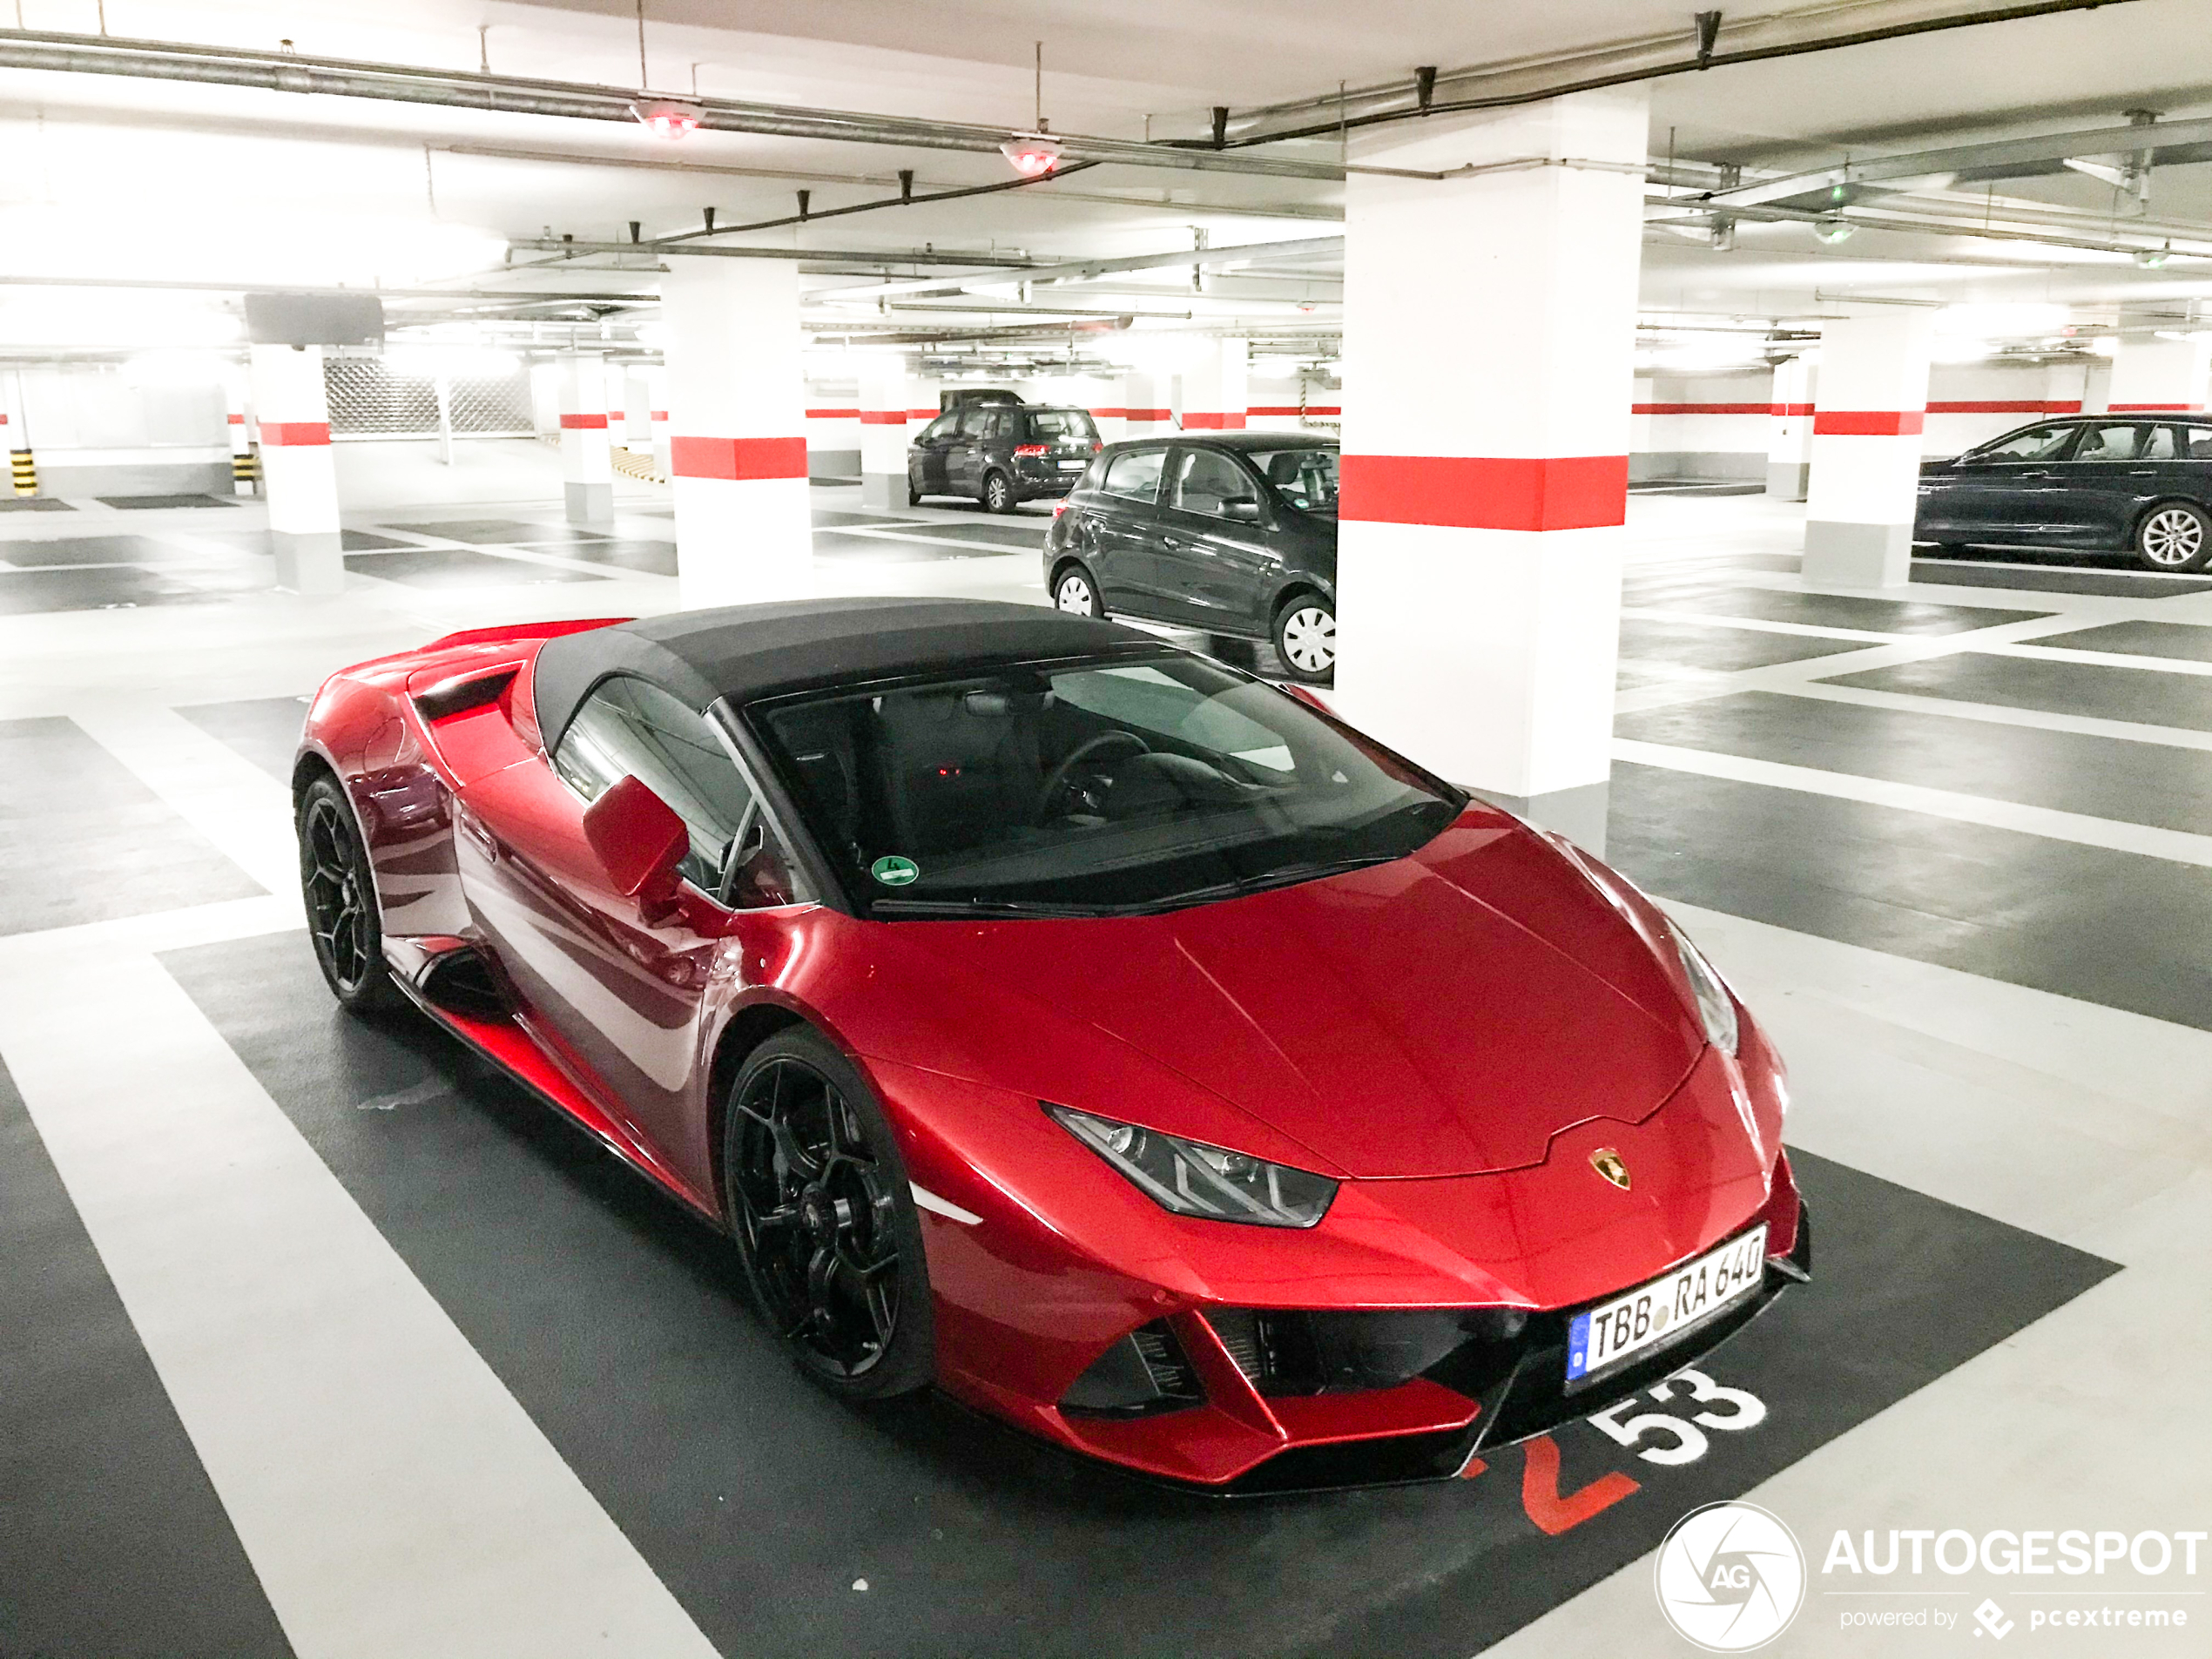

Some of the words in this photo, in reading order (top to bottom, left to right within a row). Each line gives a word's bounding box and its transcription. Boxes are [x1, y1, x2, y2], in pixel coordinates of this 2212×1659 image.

[1595, 1295, 1651, 1358] TBB
[1674, 1265, 1707, 1321] RA
[1715, 1236, 1761, 1298] 640
